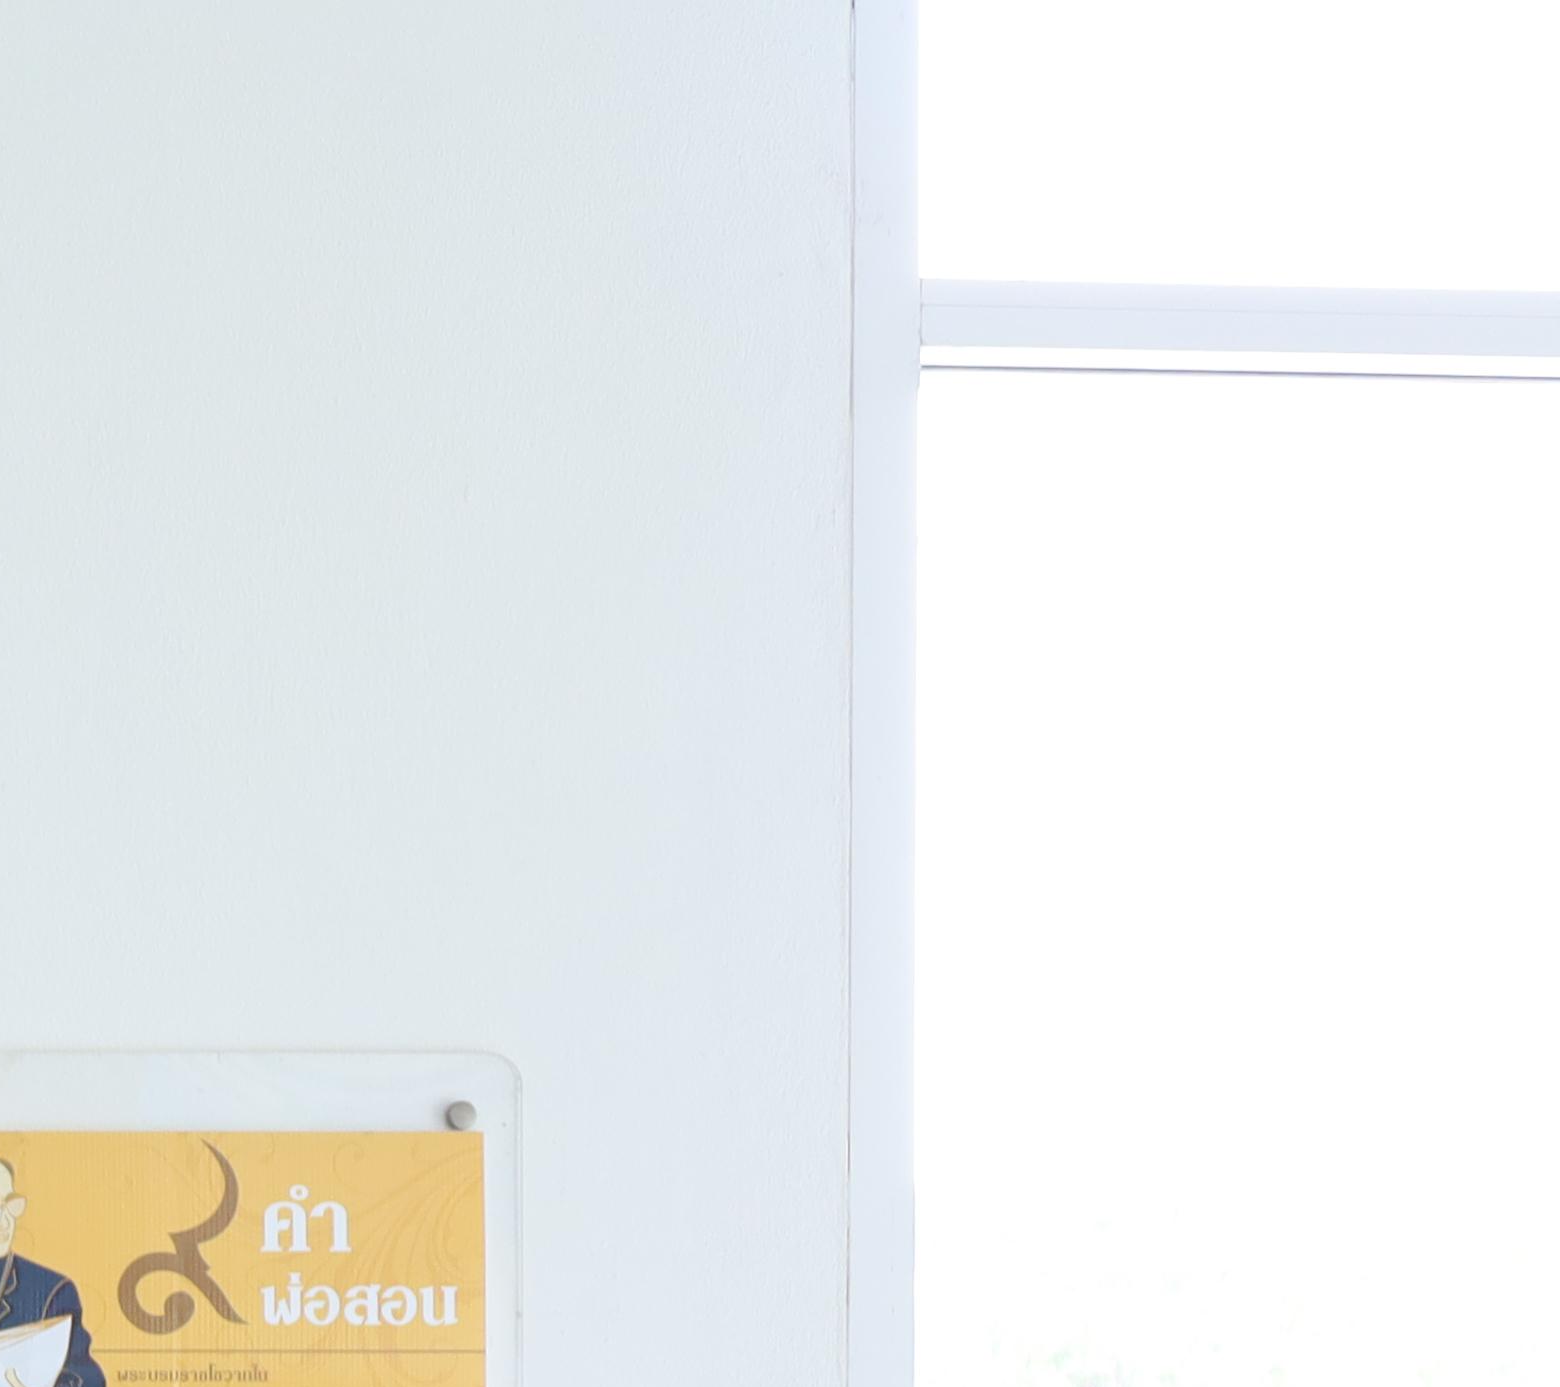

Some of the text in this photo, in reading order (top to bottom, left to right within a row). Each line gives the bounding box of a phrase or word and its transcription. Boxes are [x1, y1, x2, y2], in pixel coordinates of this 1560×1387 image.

[118, 1139, 351, 1335] ๙ คำ
[262, 1272, 459, 1327] พ่อสอน
